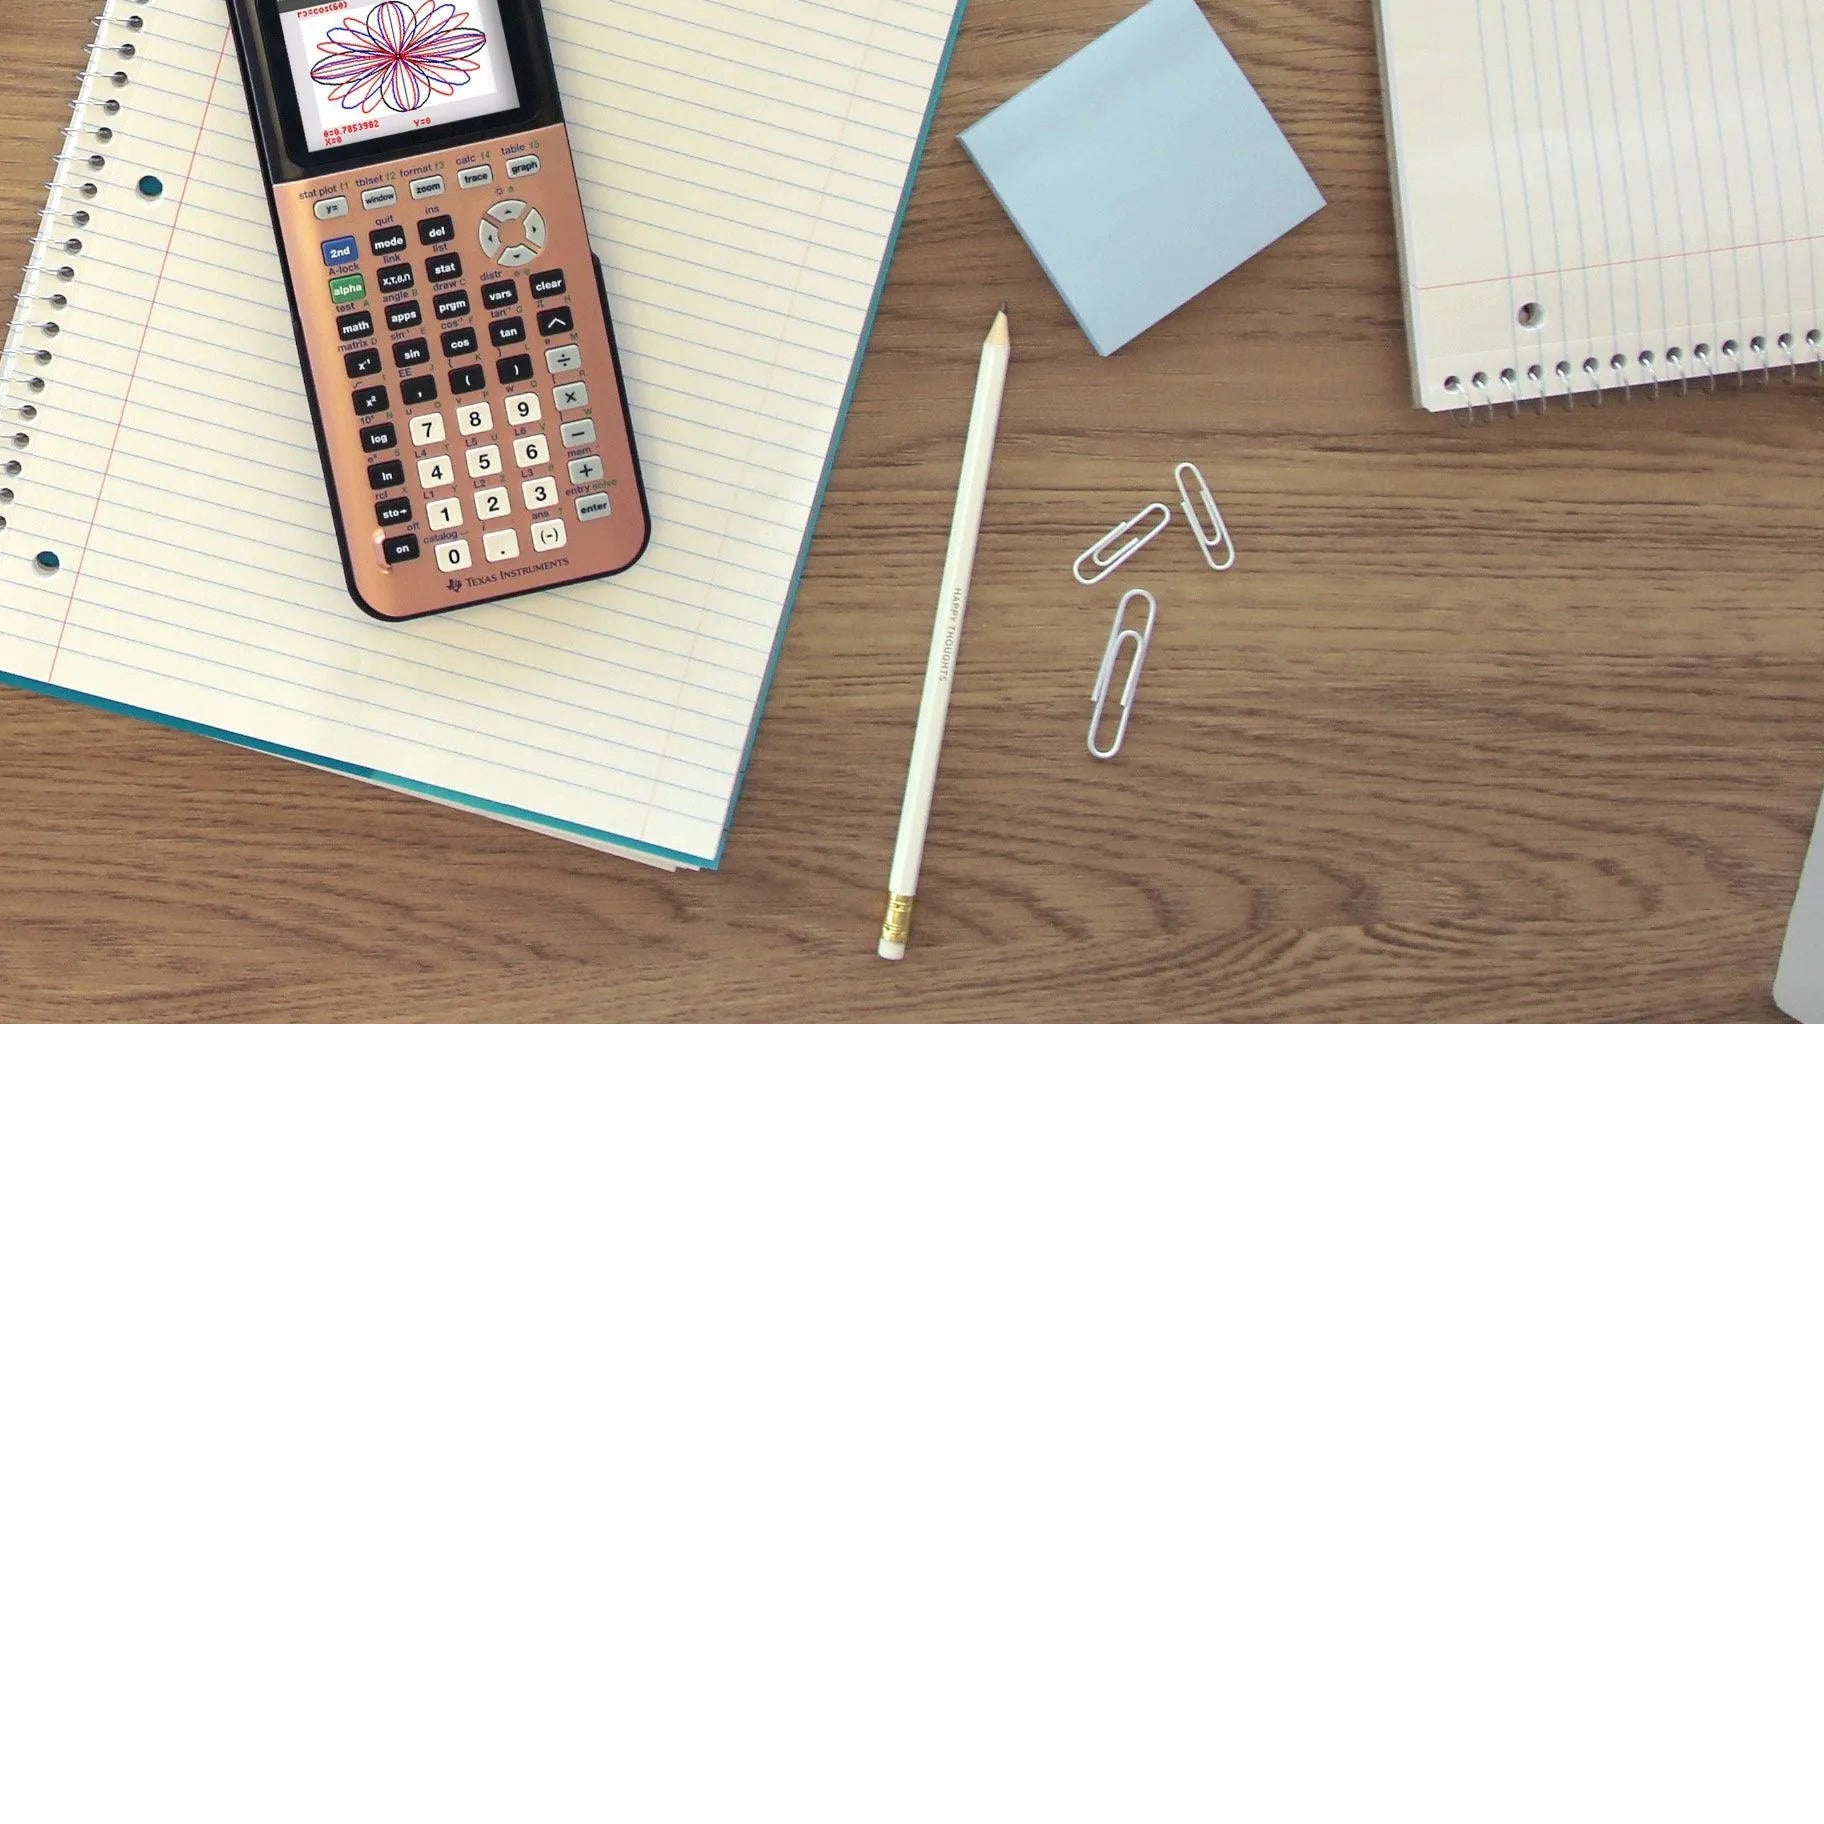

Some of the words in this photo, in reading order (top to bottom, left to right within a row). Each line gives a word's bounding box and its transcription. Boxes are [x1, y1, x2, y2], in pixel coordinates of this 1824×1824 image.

[511, 160, 537, 174] graph
[464, 173, 488, 183] trace
[416, 183, 440, 194] zoom
[365, 193, 395, 204] window
[428, 226, 445, 237] del
[374, 236, 403, 249] mode
[330, 245, 350, 258] 2nd
[434, 262, 455, 274] stat
[333, 284, 362, 295] alpha
[535, 279, 562, 291] clear
[489, 290, 512, 300] vars
[438, 300, 466, 313] prgm
[391, 311, 416, 323] apps
[342, 320, 369, 333] math
[499, 328, 517, 337] tan
[450, 339, 469, 348] cos
[404, 349, 420, 359] sin
[517, 401, 529, 417] 9
[469, 411, 481, 426] 8
[421, 422, 432, 437] 7
[370, 434, 388, 444] log
[526, 443, 537, 459] 6
[479, 453, 490, 469] 5
[431, 465, 442, 479] 4
[534, 486, 547, 501] 3
[487, 496, 499, 512] 2
[580, 502, 607, 514] enter
[440, 506, 449, 521] 1
[395, 544, 409, 553] on
[448, 548, 460, 564] 0
[464, 573, 497, 587] TEXAS
[499, 557, 569, 580] INSTRUMENTS
[949, 587, 963, 623] HAPPY
[939, 625, 956, 682] THOUGHTS
